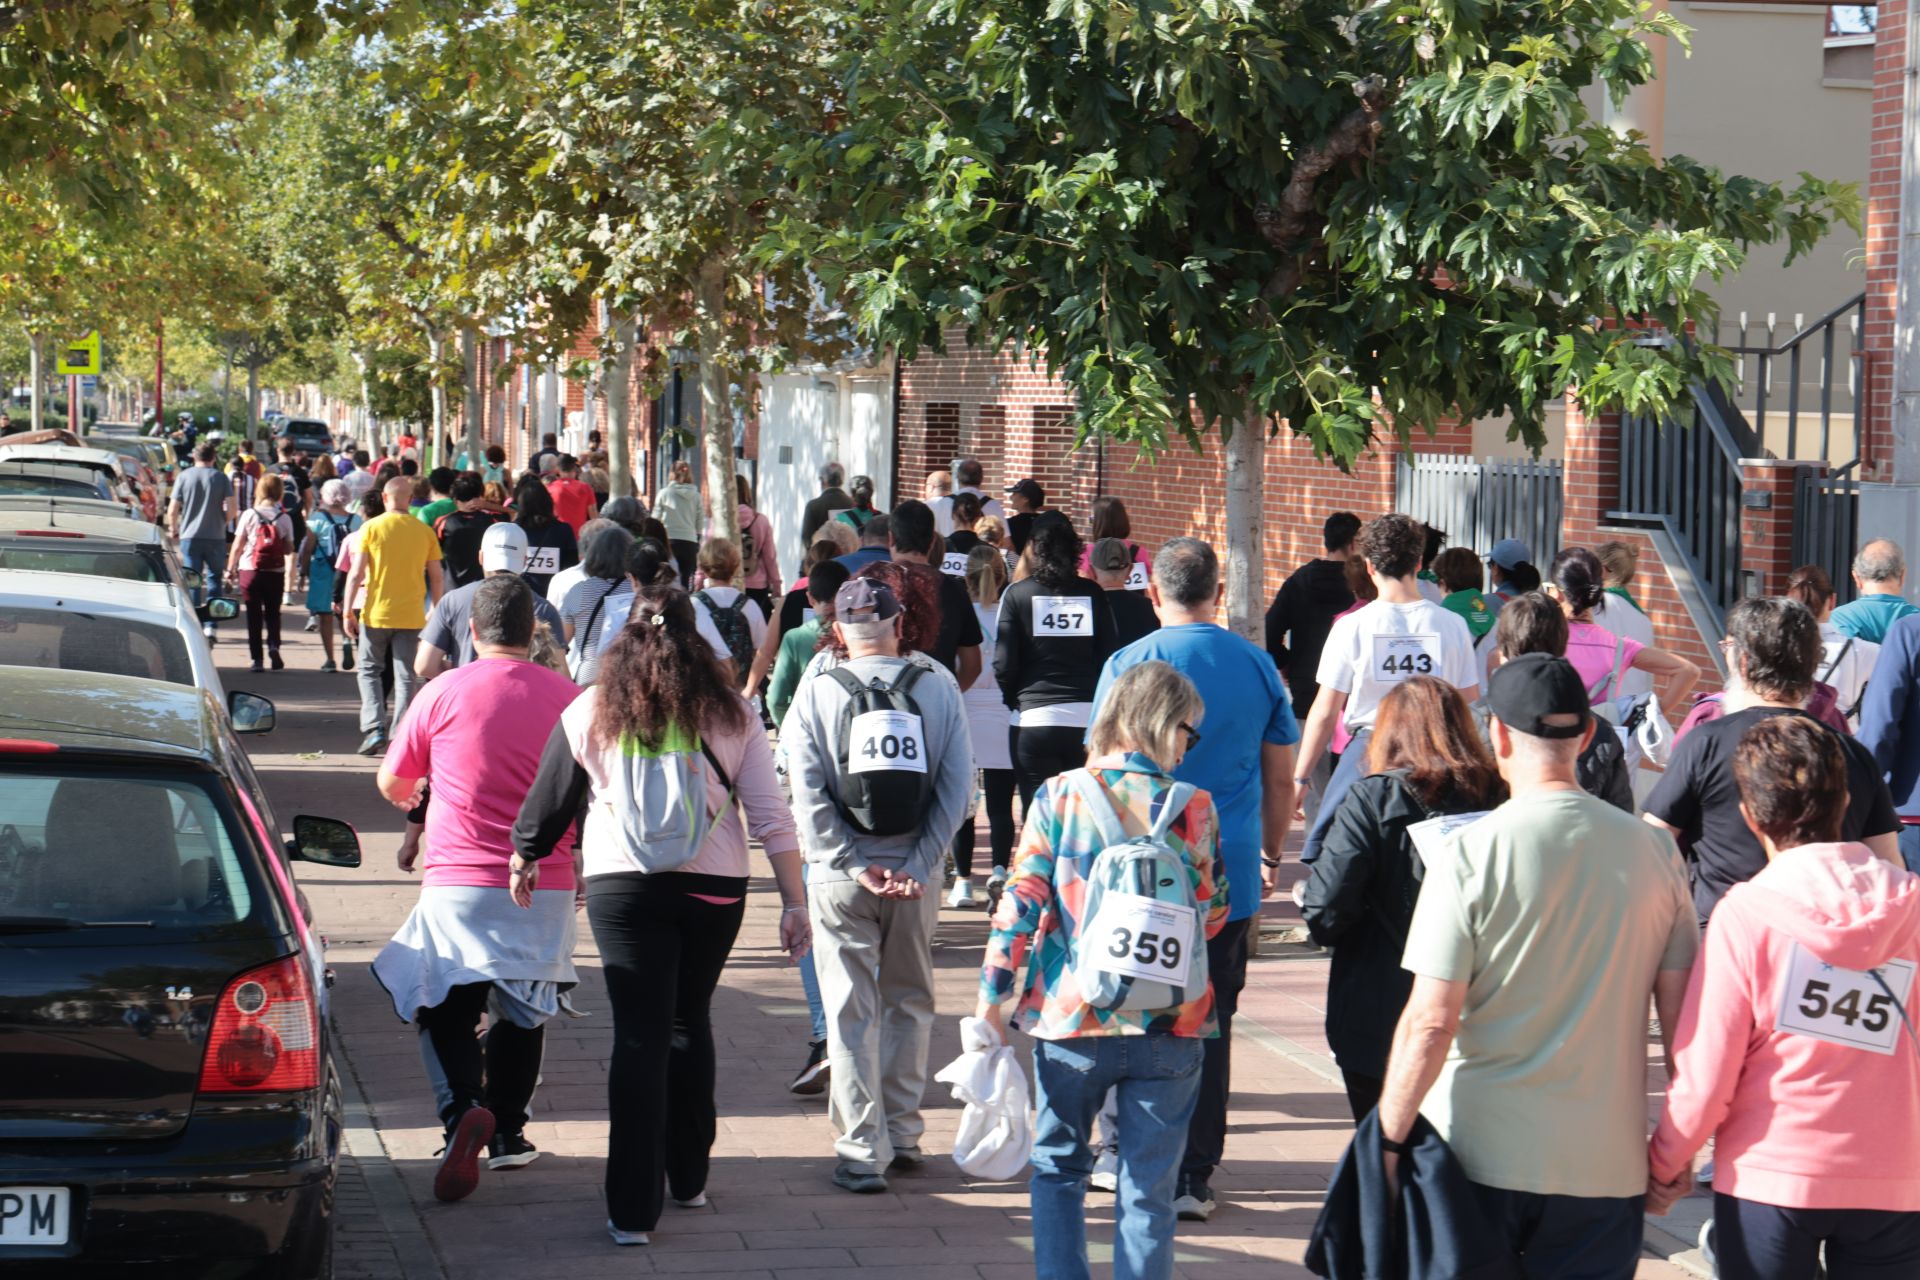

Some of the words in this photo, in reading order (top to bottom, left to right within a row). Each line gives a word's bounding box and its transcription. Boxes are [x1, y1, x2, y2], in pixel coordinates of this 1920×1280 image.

[1042, 613, 1084, 629] 457
[1382, 653, 1432, 675] 443
[861, 734, 918, 761] 408
[1108, 926, 1181, 970] 359
[1798, 978, 1893, 1033] 545
[0, 1193, 56, 1236] PM
